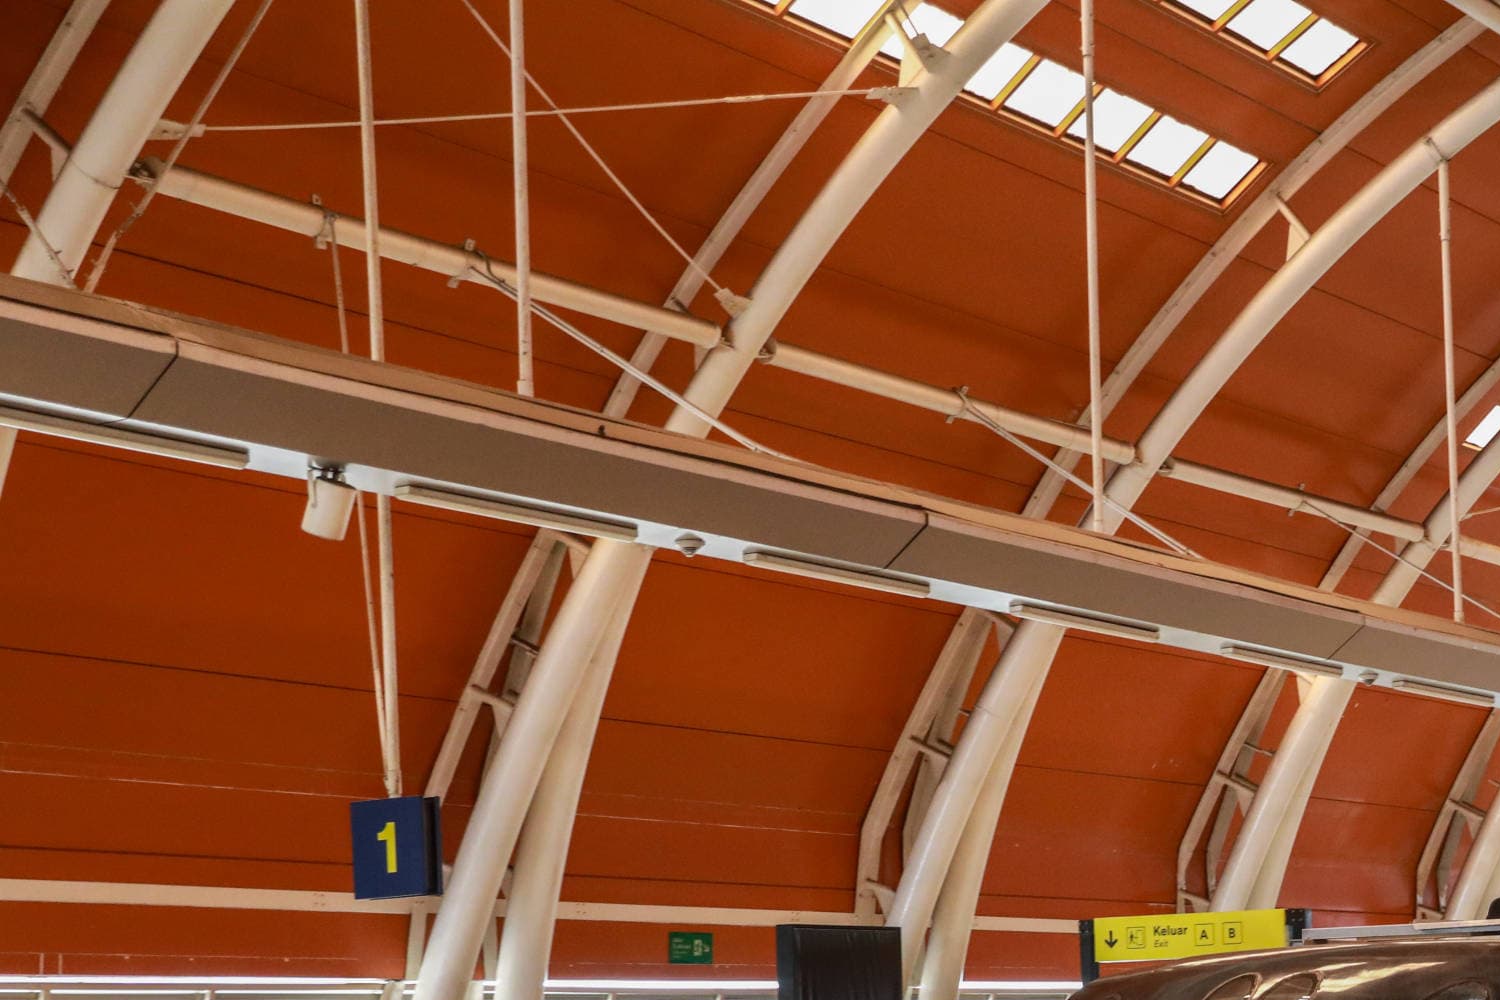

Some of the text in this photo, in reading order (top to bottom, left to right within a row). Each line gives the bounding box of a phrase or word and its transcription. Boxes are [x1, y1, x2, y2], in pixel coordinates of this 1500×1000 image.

[377, 821, 397, 873] 1
[1153, 925, 1235, 940] Keluar A B
[1154, 940, 1169, 948] Exit
